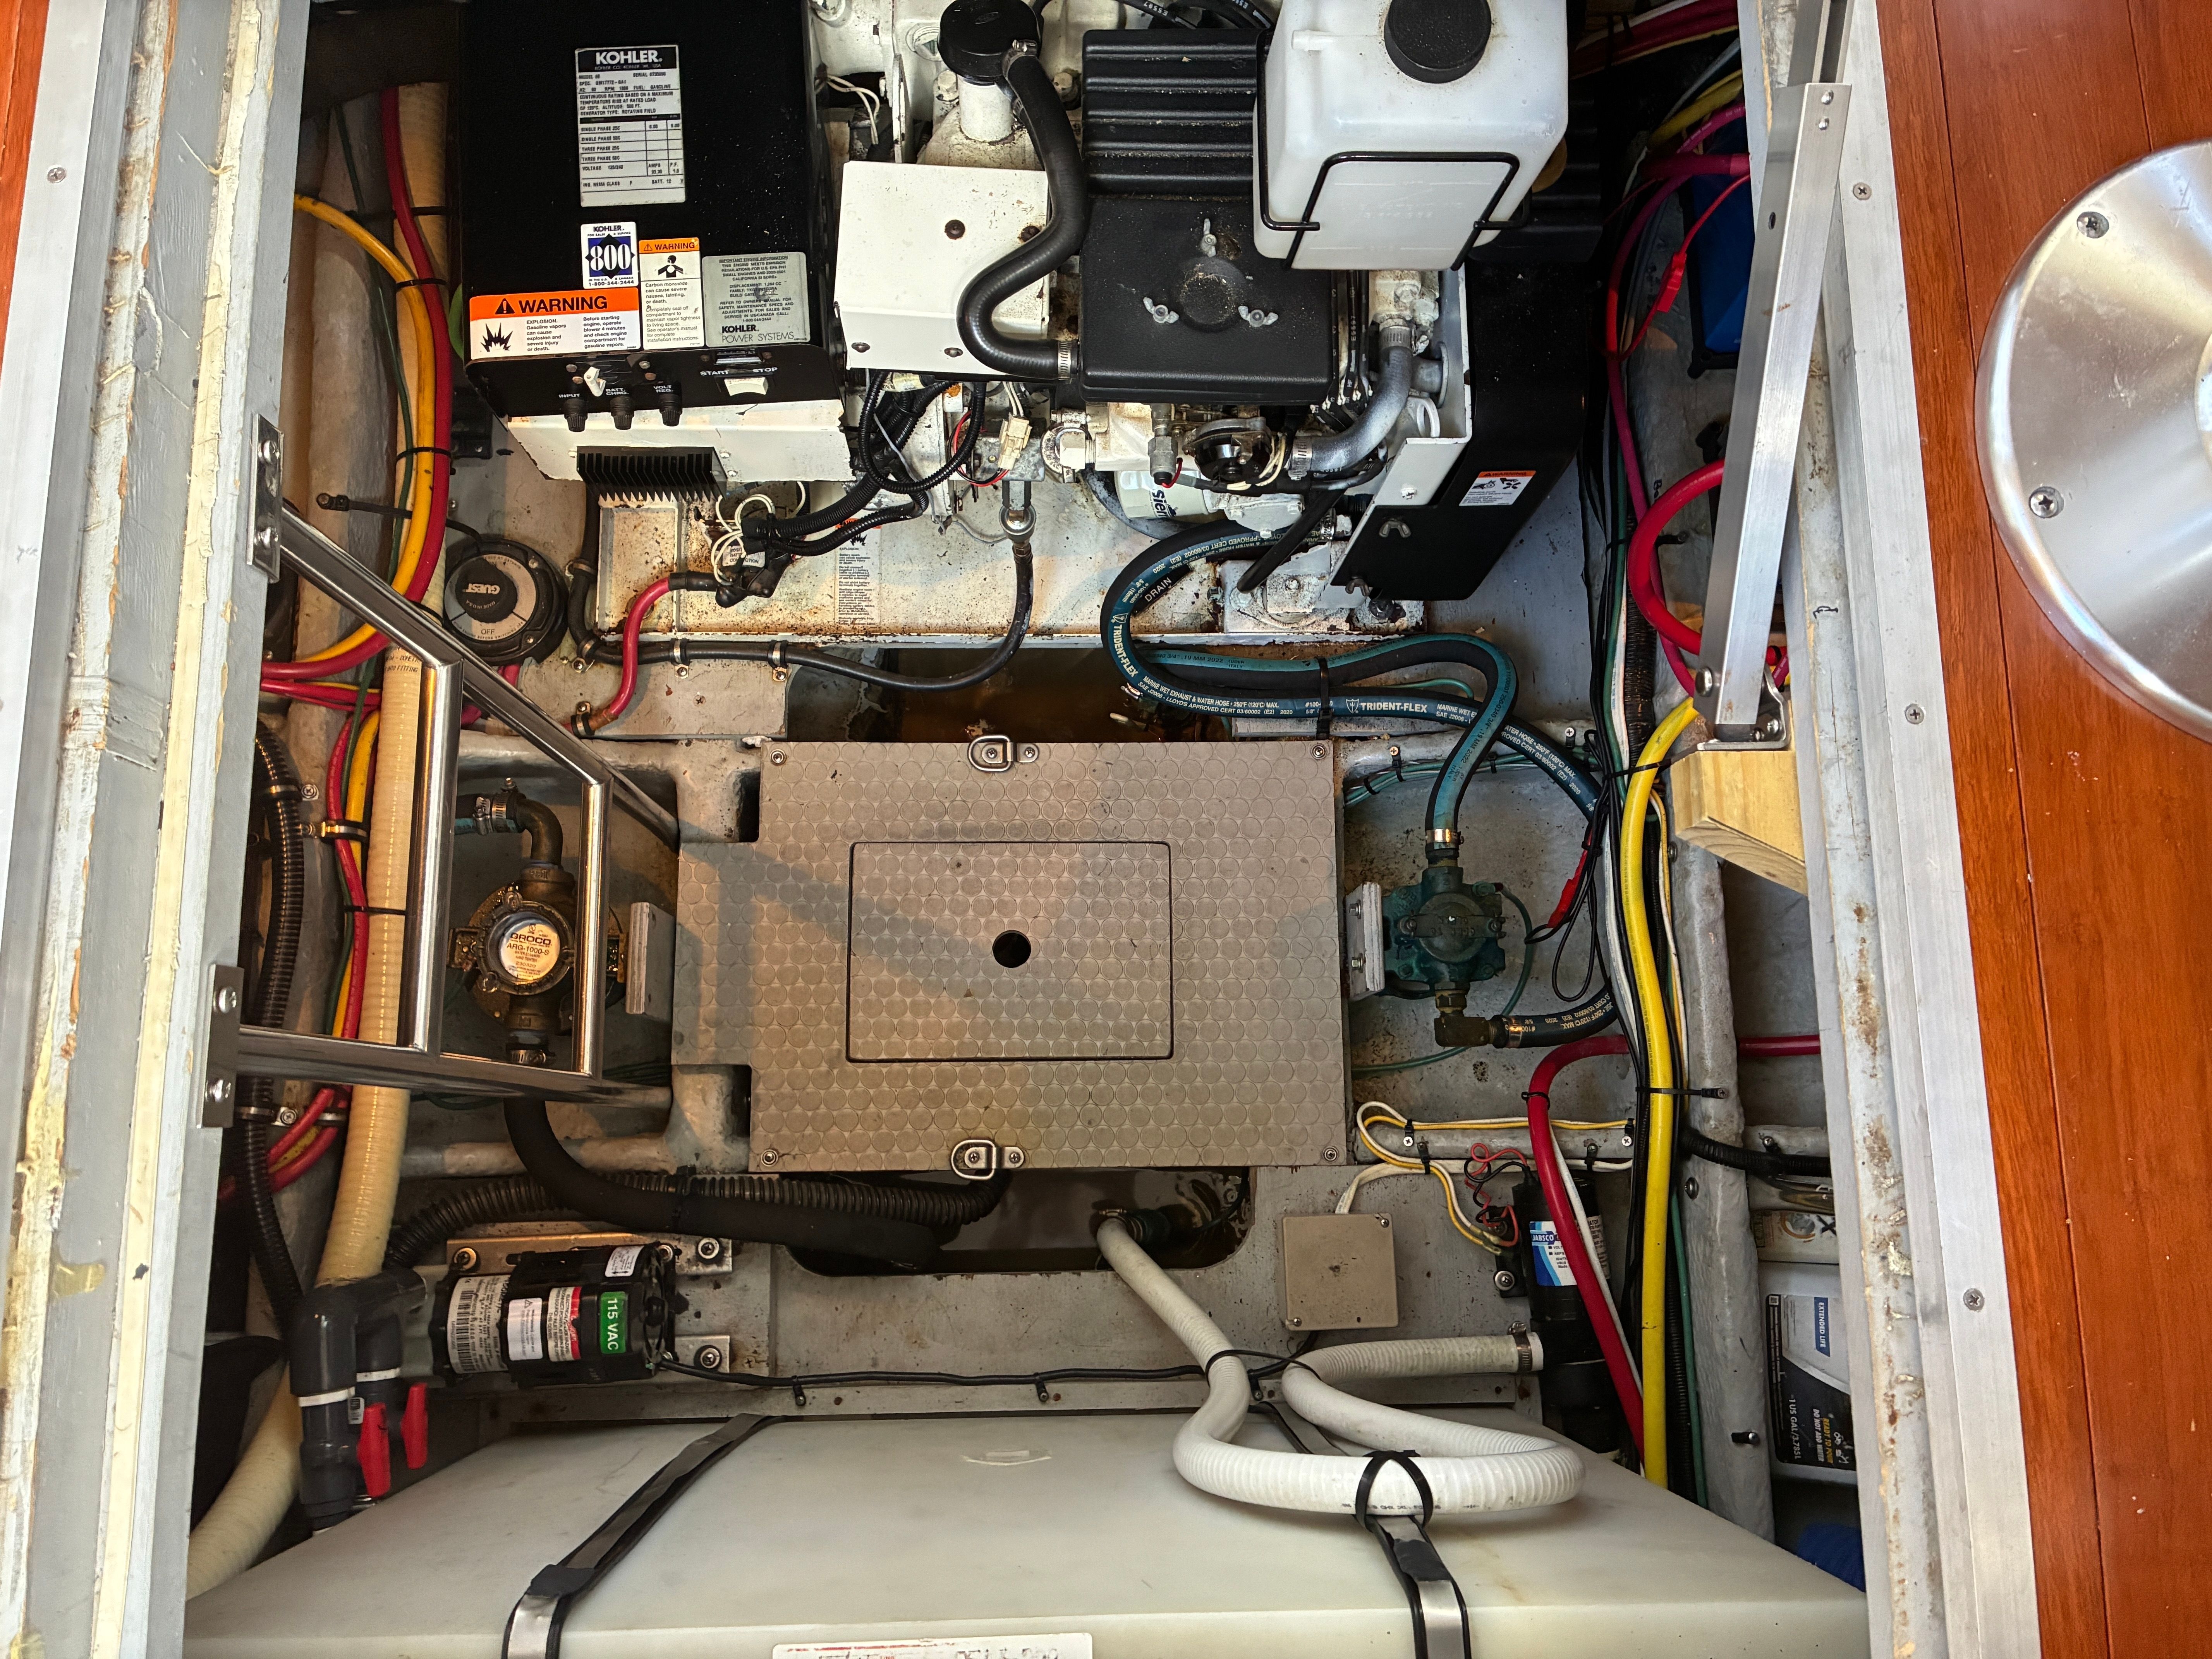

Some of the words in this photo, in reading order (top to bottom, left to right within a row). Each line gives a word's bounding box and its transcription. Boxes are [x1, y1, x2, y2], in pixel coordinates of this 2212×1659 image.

[590, 244, 631, 271] 800
[519, 296, 607, 313] WARNING
[723, 335, 753, 343] POWER
[758, 331, 794, 341] SYSTEMS
[1152, 563, 1166, 574] 2020
[465, 583, 500, 594] GUEST
[1144, 577, 1172, 602] DRAIN
[1113, 624, 1139, 677] TRIDENT-FLEX
[1143, 676, 1160, 689] MARINE
[1160, 685, 1170, 693] WET
[1170, 689, 1192, 701] EXHAUST
[1138, 682, 1148, 690] SAE
[1148, 688, 1163, 699] J2006
[1166, 697, 1187, 706] LLOYD'S
[1188, 703, 1219, 713] APPROVED
[1360, 702, 1428, 713] TRIDENT-FLEX
[1437, 704, 1458, 713] MARINE
[1449, 714, 1464, 722] J2006
[1519, 732, 1534, 744] HOSE
[1461, 749, 1472, 763] 2022
[1521, 742, 1536, 754] CERT
[1557, 770, 1567, 780] (E2)
[1569, 782, 1581, 795] 2020
[510, 933, 551, 945] GROCO
[607, 1298, 618, 1319] 115
[607, 1323, 619, 1350] VAC
[1789, 1405, 1797, 1415] US
[1790, 1417, 1802, 1459] GAL/3.785L
